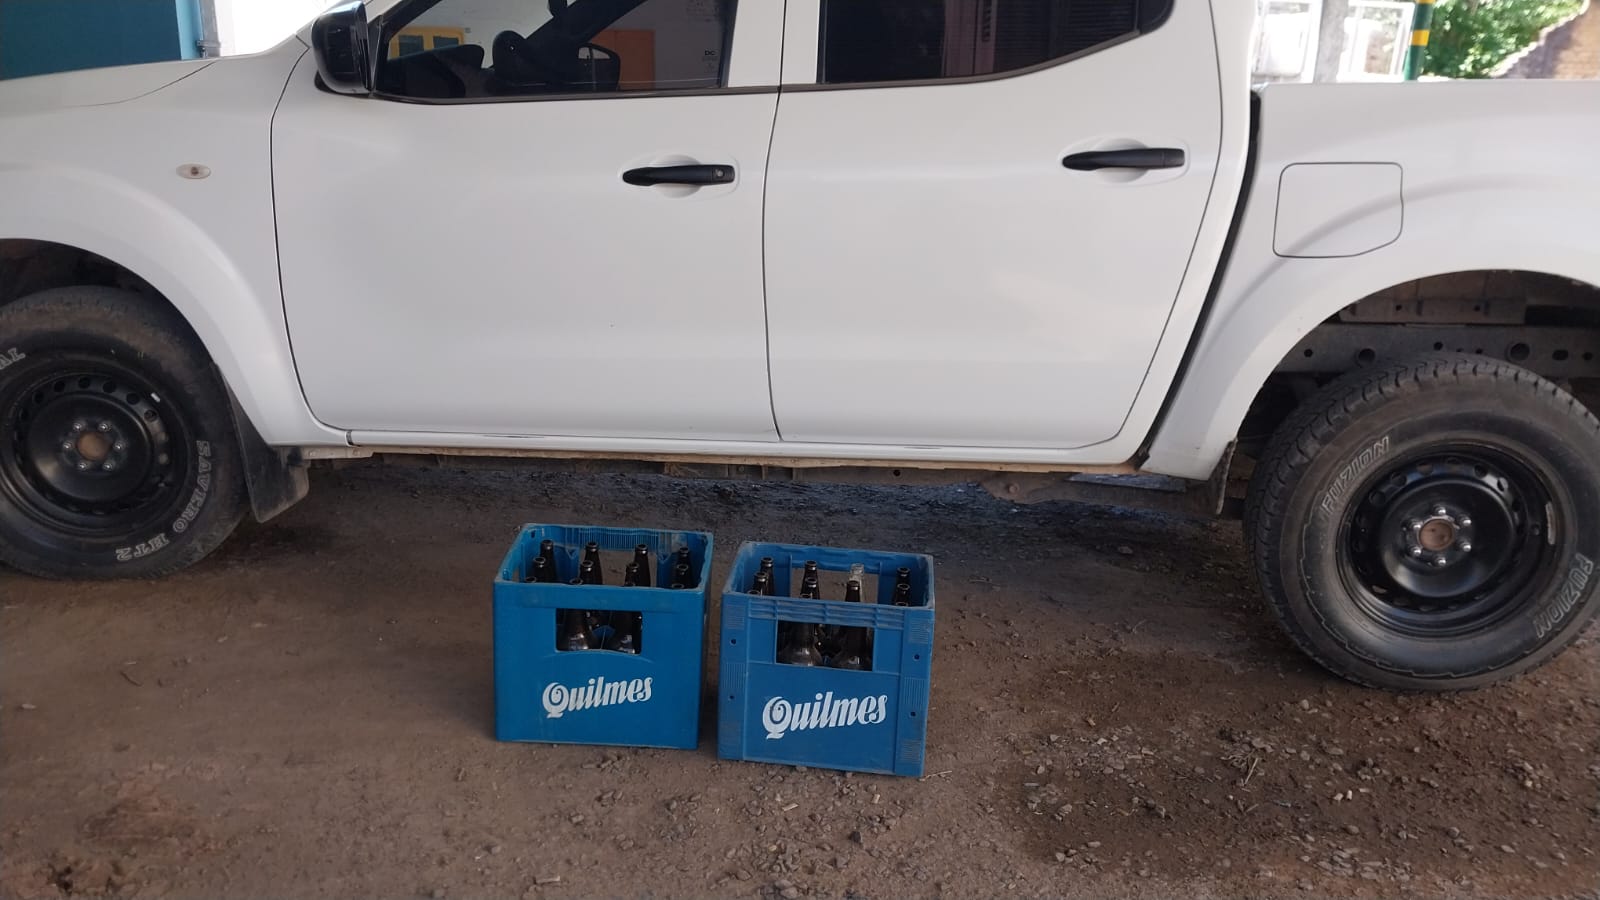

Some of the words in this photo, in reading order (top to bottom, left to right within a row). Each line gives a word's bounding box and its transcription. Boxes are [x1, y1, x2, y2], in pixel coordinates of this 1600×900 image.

[173, 440, 212, 533] SAVERO
[1320, 436, 1389, 515] FUZION
[116, 532, 170, 561] HT2
[1536, 552, 1594, 638] FUZION
[542, 676, 652, 719] Quilmes
[762, 691, 888, 740] Quilmes
